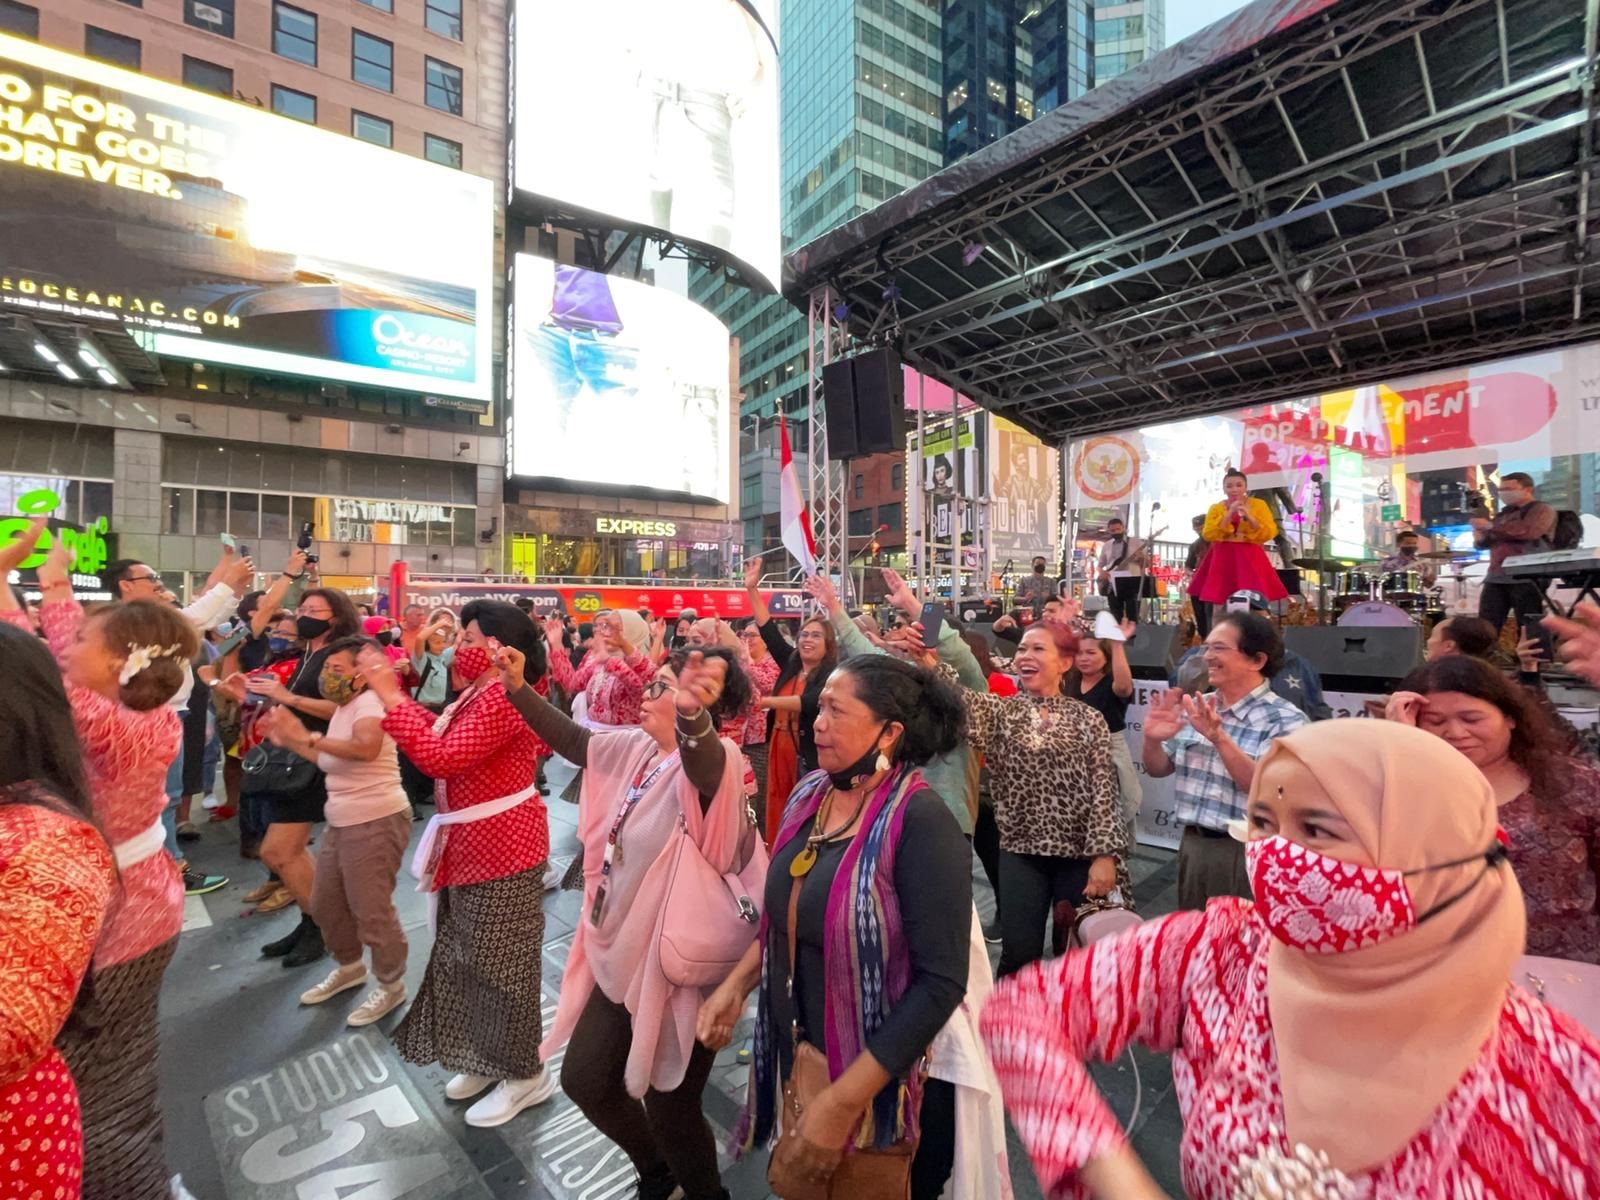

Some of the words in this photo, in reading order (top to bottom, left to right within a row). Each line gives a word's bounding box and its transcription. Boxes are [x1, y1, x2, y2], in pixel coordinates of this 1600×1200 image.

[43, 85, 136, 132] FOR
[95, 131, 210, 176] GOES
[373, 314, 471, 356] Ocean
[596, 517, 677, 537] EXPRESS
[575, 597, 601, 611] $29
[225, 1033, 389, 1138] STUDIO
